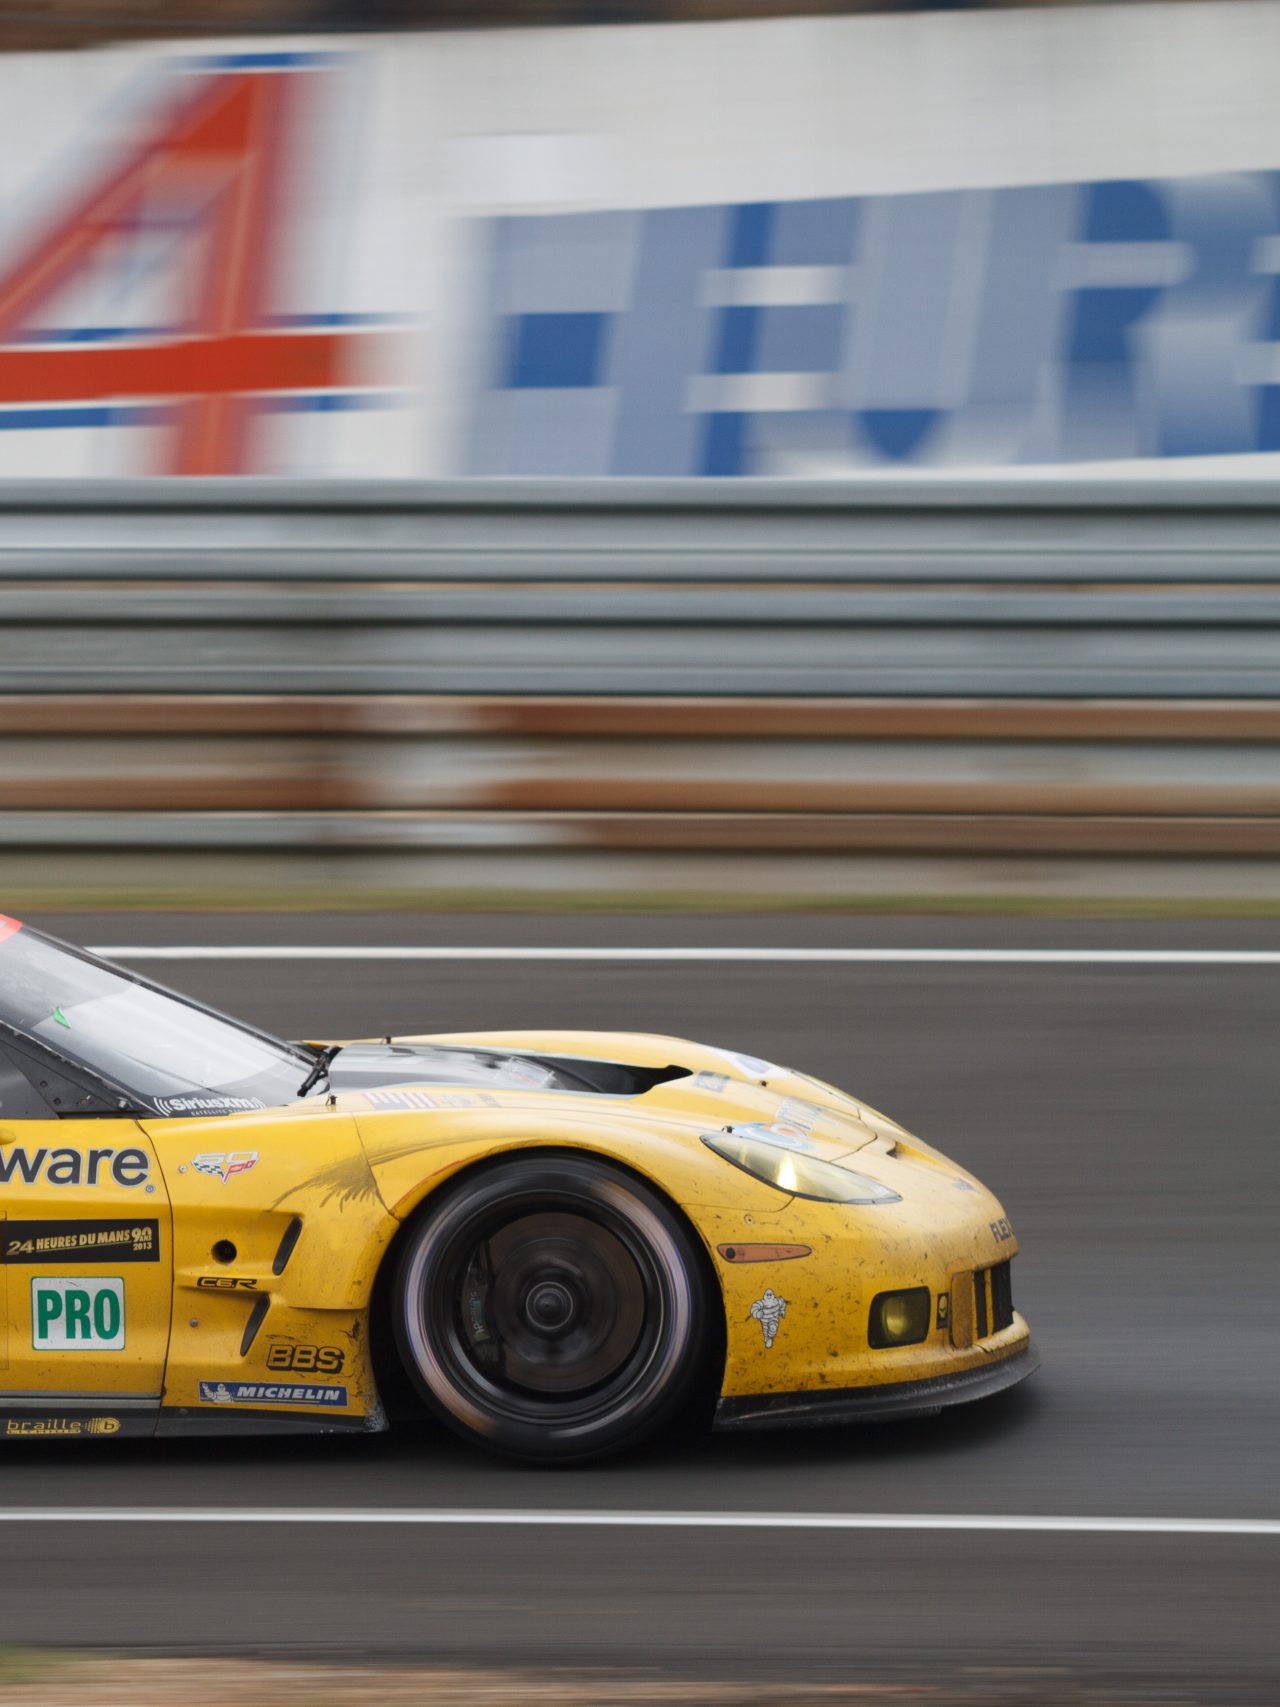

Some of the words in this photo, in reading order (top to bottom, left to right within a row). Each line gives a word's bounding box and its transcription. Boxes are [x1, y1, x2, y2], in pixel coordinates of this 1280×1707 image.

[6, 1240, 35, 1256] 24
[36, 1235, 77, 1250] HEURES
[79, 1231, 96, 1246] DU
[97, 1229, 130, 1244] MANS
[132, 1242, 152, 1251] 2013
[37, 1289, 120, 1340] PRO
[266, 1344, 345, 1374] BBS
[236, 1386, 341, 1400] MICHELIN
[7, 1419, 81, 1430] braille
